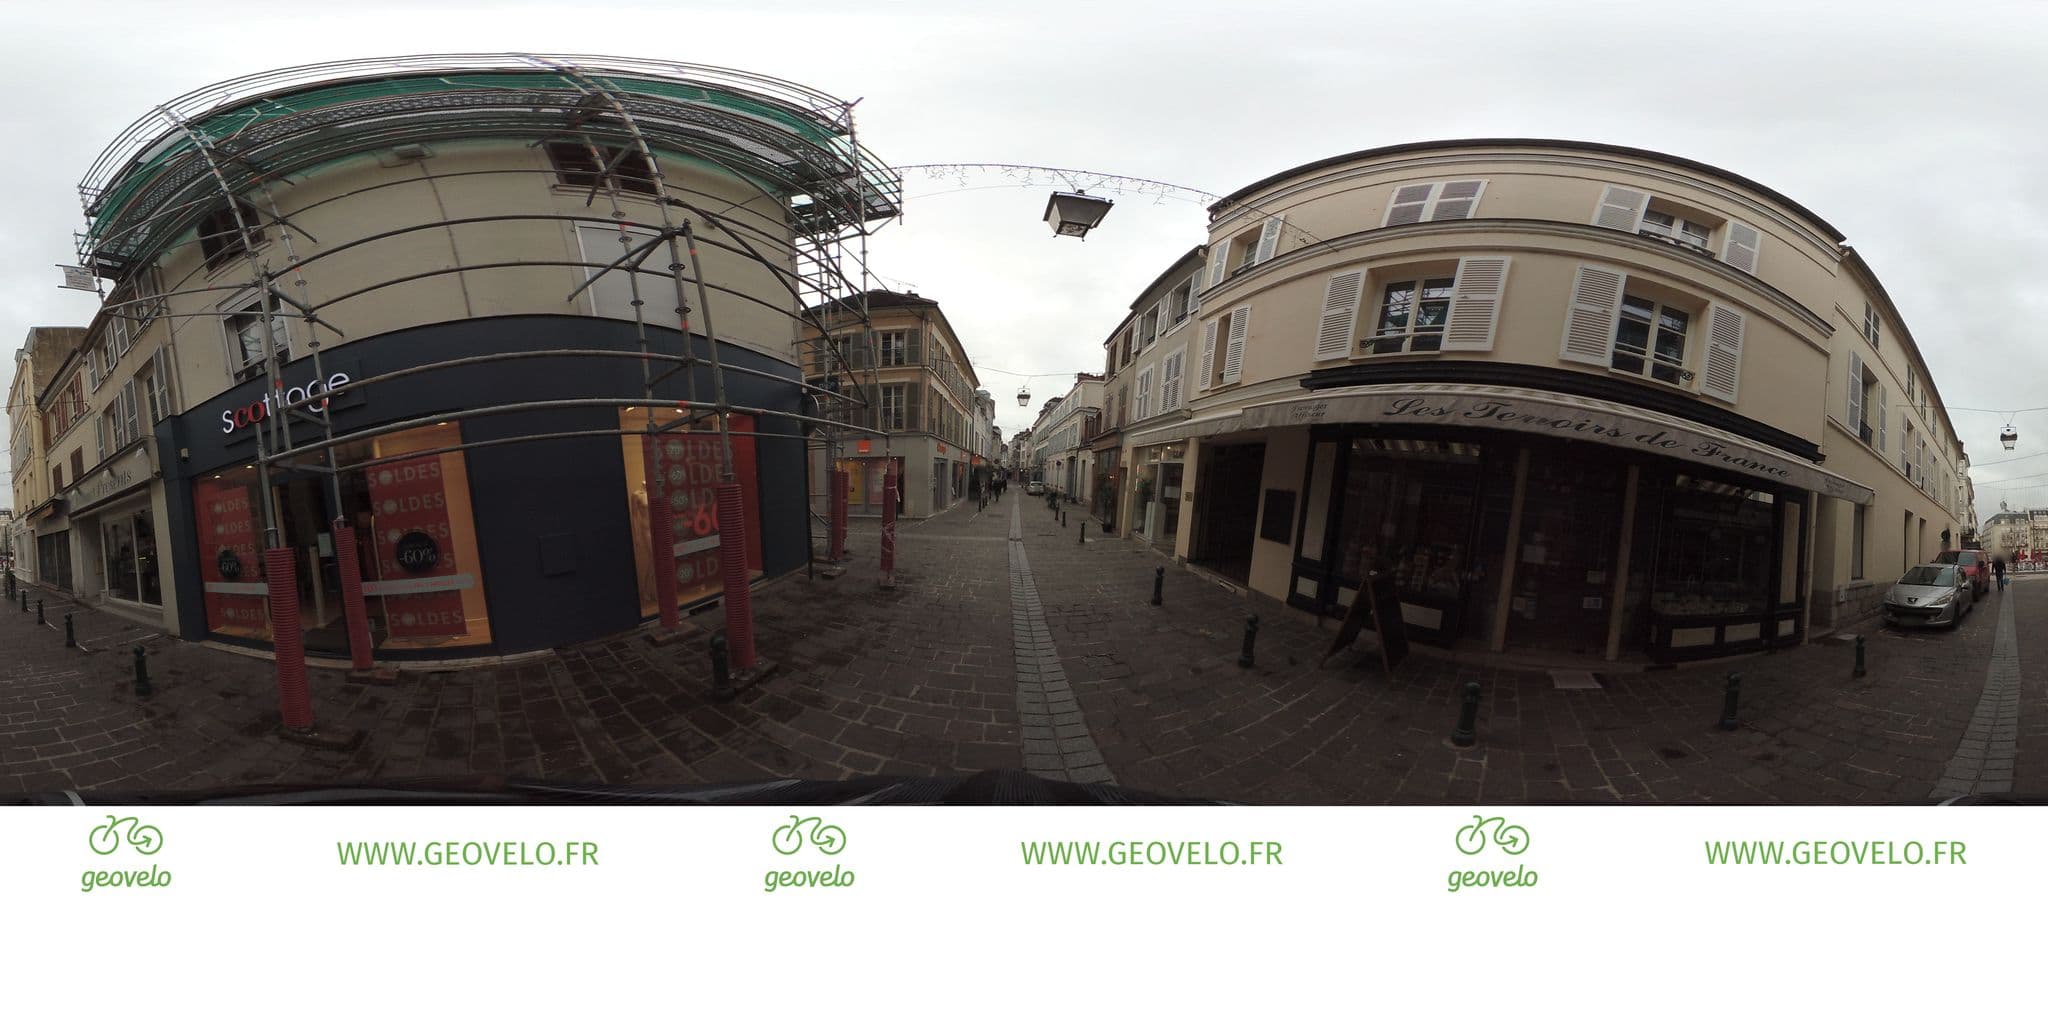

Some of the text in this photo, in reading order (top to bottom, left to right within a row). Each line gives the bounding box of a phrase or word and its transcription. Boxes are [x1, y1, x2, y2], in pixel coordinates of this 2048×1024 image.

[1383, 398, 1791, 478] Les Terroirs de France
